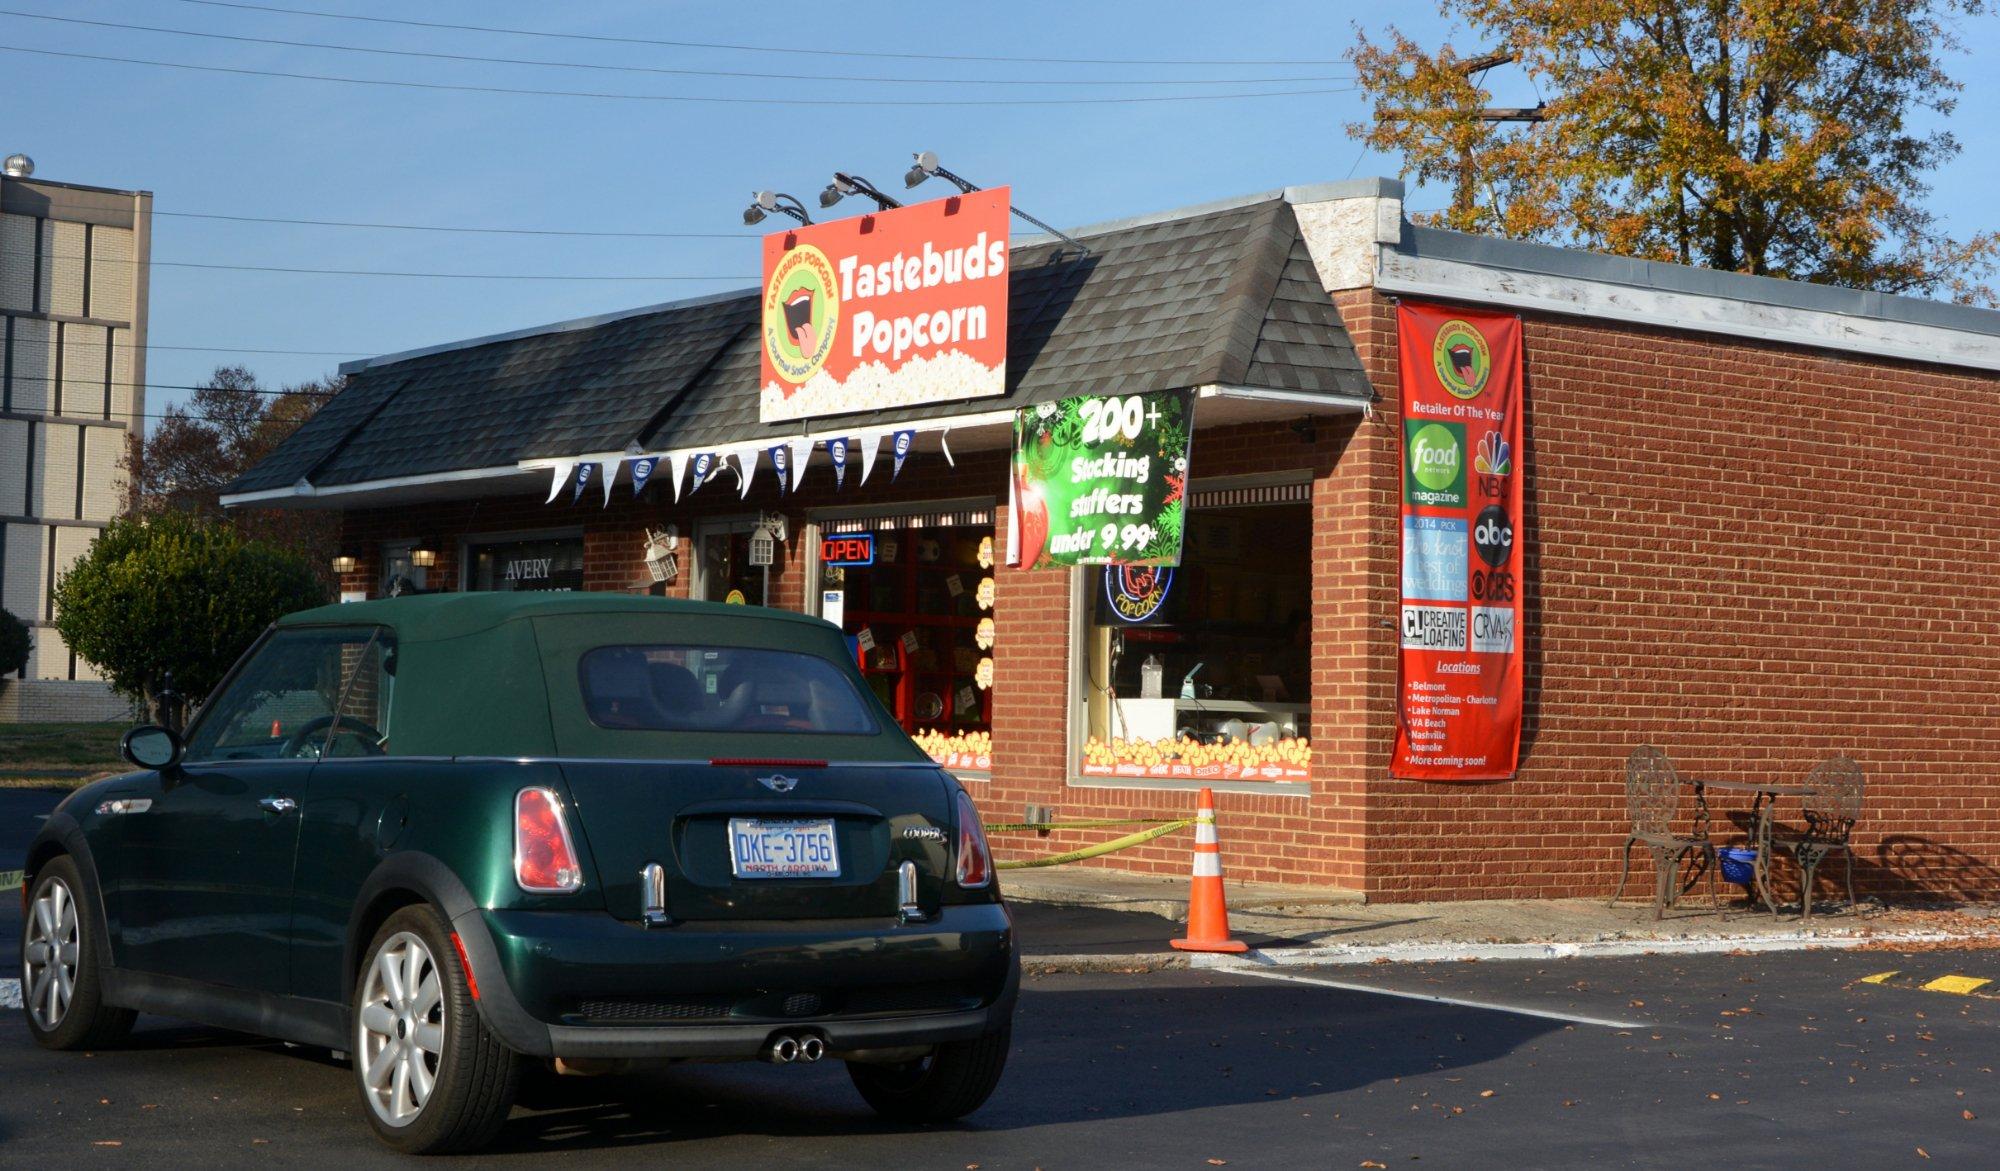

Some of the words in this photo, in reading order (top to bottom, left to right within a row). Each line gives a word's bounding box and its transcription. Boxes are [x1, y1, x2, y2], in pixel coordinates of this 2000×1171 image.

[838, 231, 1005, 302] Tastebuds
[768, 251, 803, 310] TASTEBUDS
[804, 252, 834, 299] POPCORN
[852, 304, 987, 362] Popcorn
[767, 327, 774, 336] A
[791, 363, 811, 376] Snack
[811, 316, 836, 366] Company
[1079, 395, 1162, 443] 200+
[1412, 400, 1451, 415] Retailer
[1453, 404, 1465, 416] Of
[1466, 405, 1483, 419] The
[1484, 408, 1504, 420] Year
[1412, 437, 1458, 474] food
[1424, 466, 1450, 474] network
[1412, 490, 1459, 504] magazine
[1478, 476, 1508, 498] NBC
[1414, 518, 1436, 529] 2014
[1440, 521, 1456, 531] PICK
[1474, 518, 1513, 547] abc
[1050, 525, 1096, 554] under
[1434, 530, 1467, 557] knot
[821, 540, 869, 560] OPEN
[504, 558, 551, 580] AVERY
[1447, 556, 1460, 574] of
[1486, 571, 1516, 602] CBS
[1115, 585, 1164, 617] POPCORN
[1423, 610, 1466, 629] CREATIVE
[1473, 613, 1504, 639] CRVA
[1423, 628, 1465, 647] LOAFING
[1436, 660, 1481, 674] Locations
[1413, 681, 1446, 691] Belmont
[1412, 693, 1461, 705] Metropolitan
[1466, 694, 1498, 705] Charlotte
[1411, 706, 1431, 715] Lake
[1432, 707, 1460, 716] Norman
[1411, 718, 1423, 727] VA
[1424, 718, 1446, 728] Beach
[1411, 730, 1446, 740] Nashville
[1411, 742, 1443, 752] Roanoke
[1195, 765, 1220, 776] OREO
[1409, 755, 1434, 765] More
[1433, 756, 1464, 768] coming
[1465, 755, 1486, 766] soon!
[737, 833, 831, 863] DKE-3756
[745, 864, 779, 872] NORTH
[782, 864, 828, 872] CAROLINA
